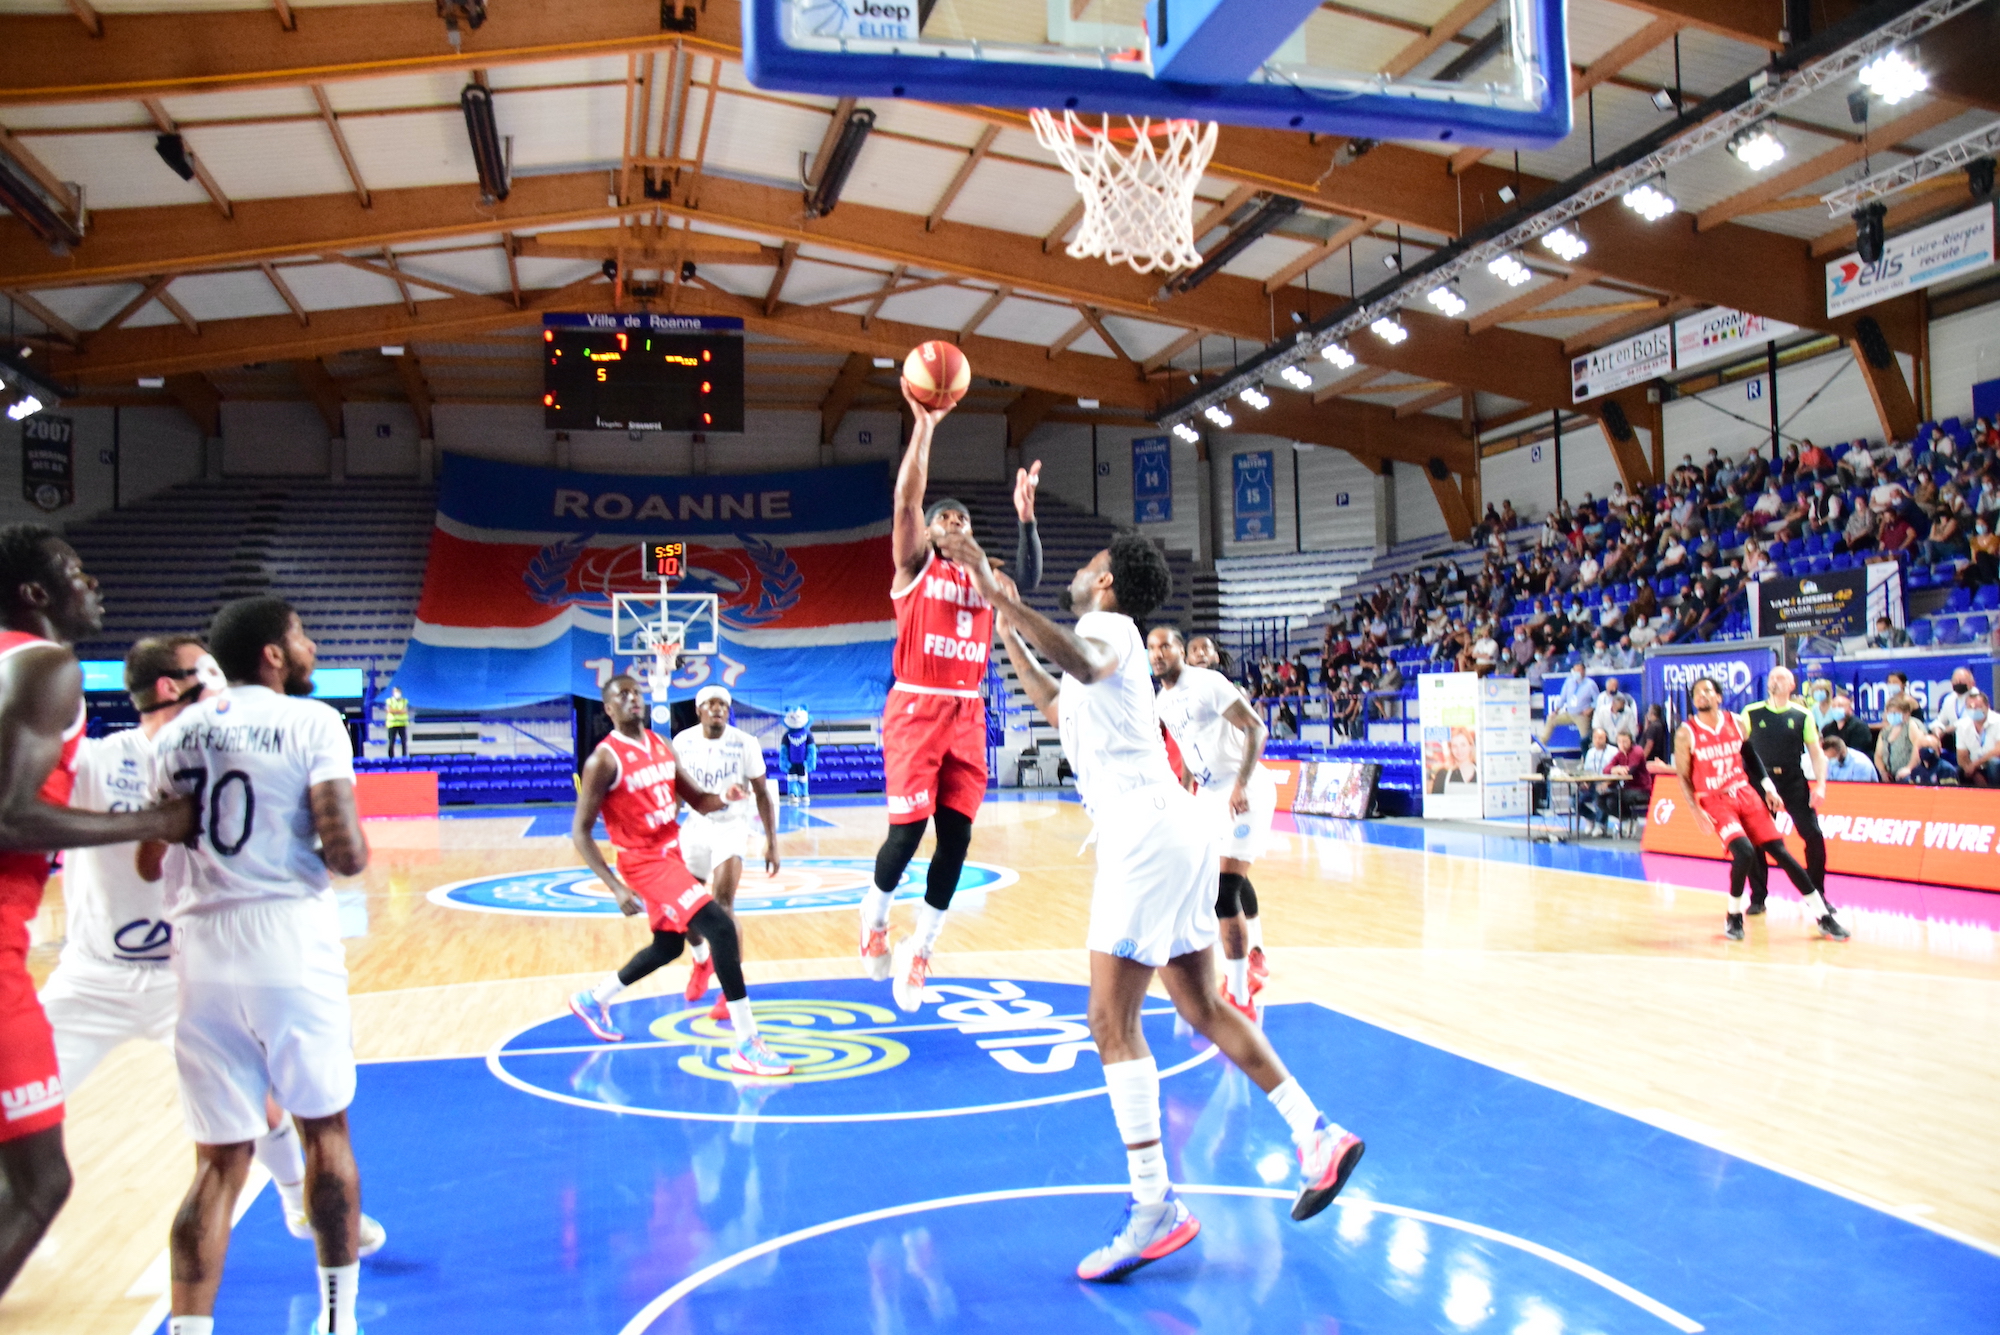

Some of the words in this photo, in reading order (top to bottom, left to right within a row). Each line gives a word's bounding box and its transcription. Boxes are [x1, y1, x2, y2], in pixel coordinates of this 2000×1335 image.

[854, 0, 911, 22] Jeep
[1859, 248, 1904, 286] elis
[587, 314, 617, 327] Ville
[624, 314, 641, 328] de
[649, 315, 702, 329] Roanne
[1591, 354, 1613, 376] Art
[1616, 346, 1631, 361] en
[1632, 332, 1668, 361] Bois
[1748, 382, 1759, 398] R
[25, 419, 70, 442] 2007
[1145, 472, 1159, 487] 14
[553, 488, 792, 521] ROANNE
[1246, 487, 1260, 504] 15
[655, 543, 682, 558] 5:59
[657, 558, 678, 575] 10
[956, 610, 974, 639] 9
[173, 767, 255, 855] 70
[1816, 813, 1921, 845] MPLEMENT
[1923, 820, 1994, 852] VIVRE
